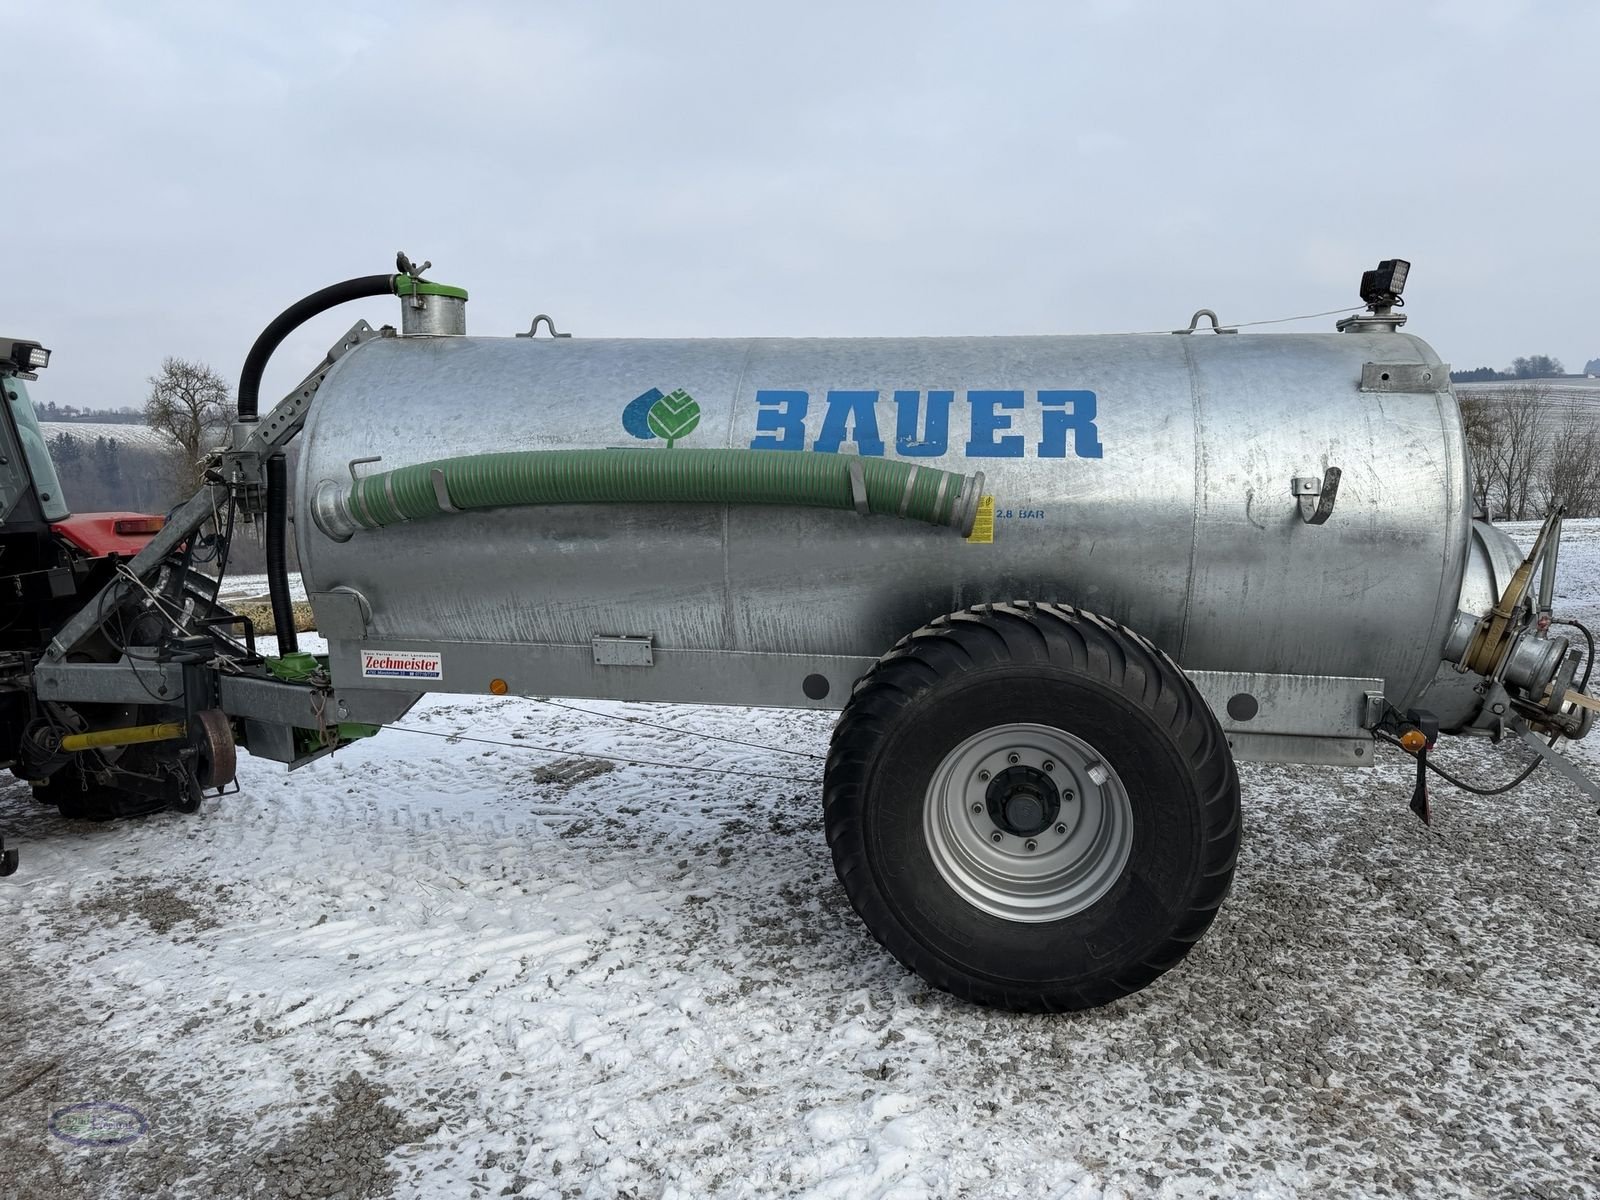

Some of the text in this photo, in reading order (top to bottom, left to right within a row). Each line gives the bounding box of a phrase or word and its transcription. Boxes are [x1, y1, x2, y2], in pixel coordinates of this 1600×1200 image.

[750, 390, 1103, 458] BAUER
[1019, 509, 1045, 519] BAR
[365, 656, 438, 670] Zechmeister
